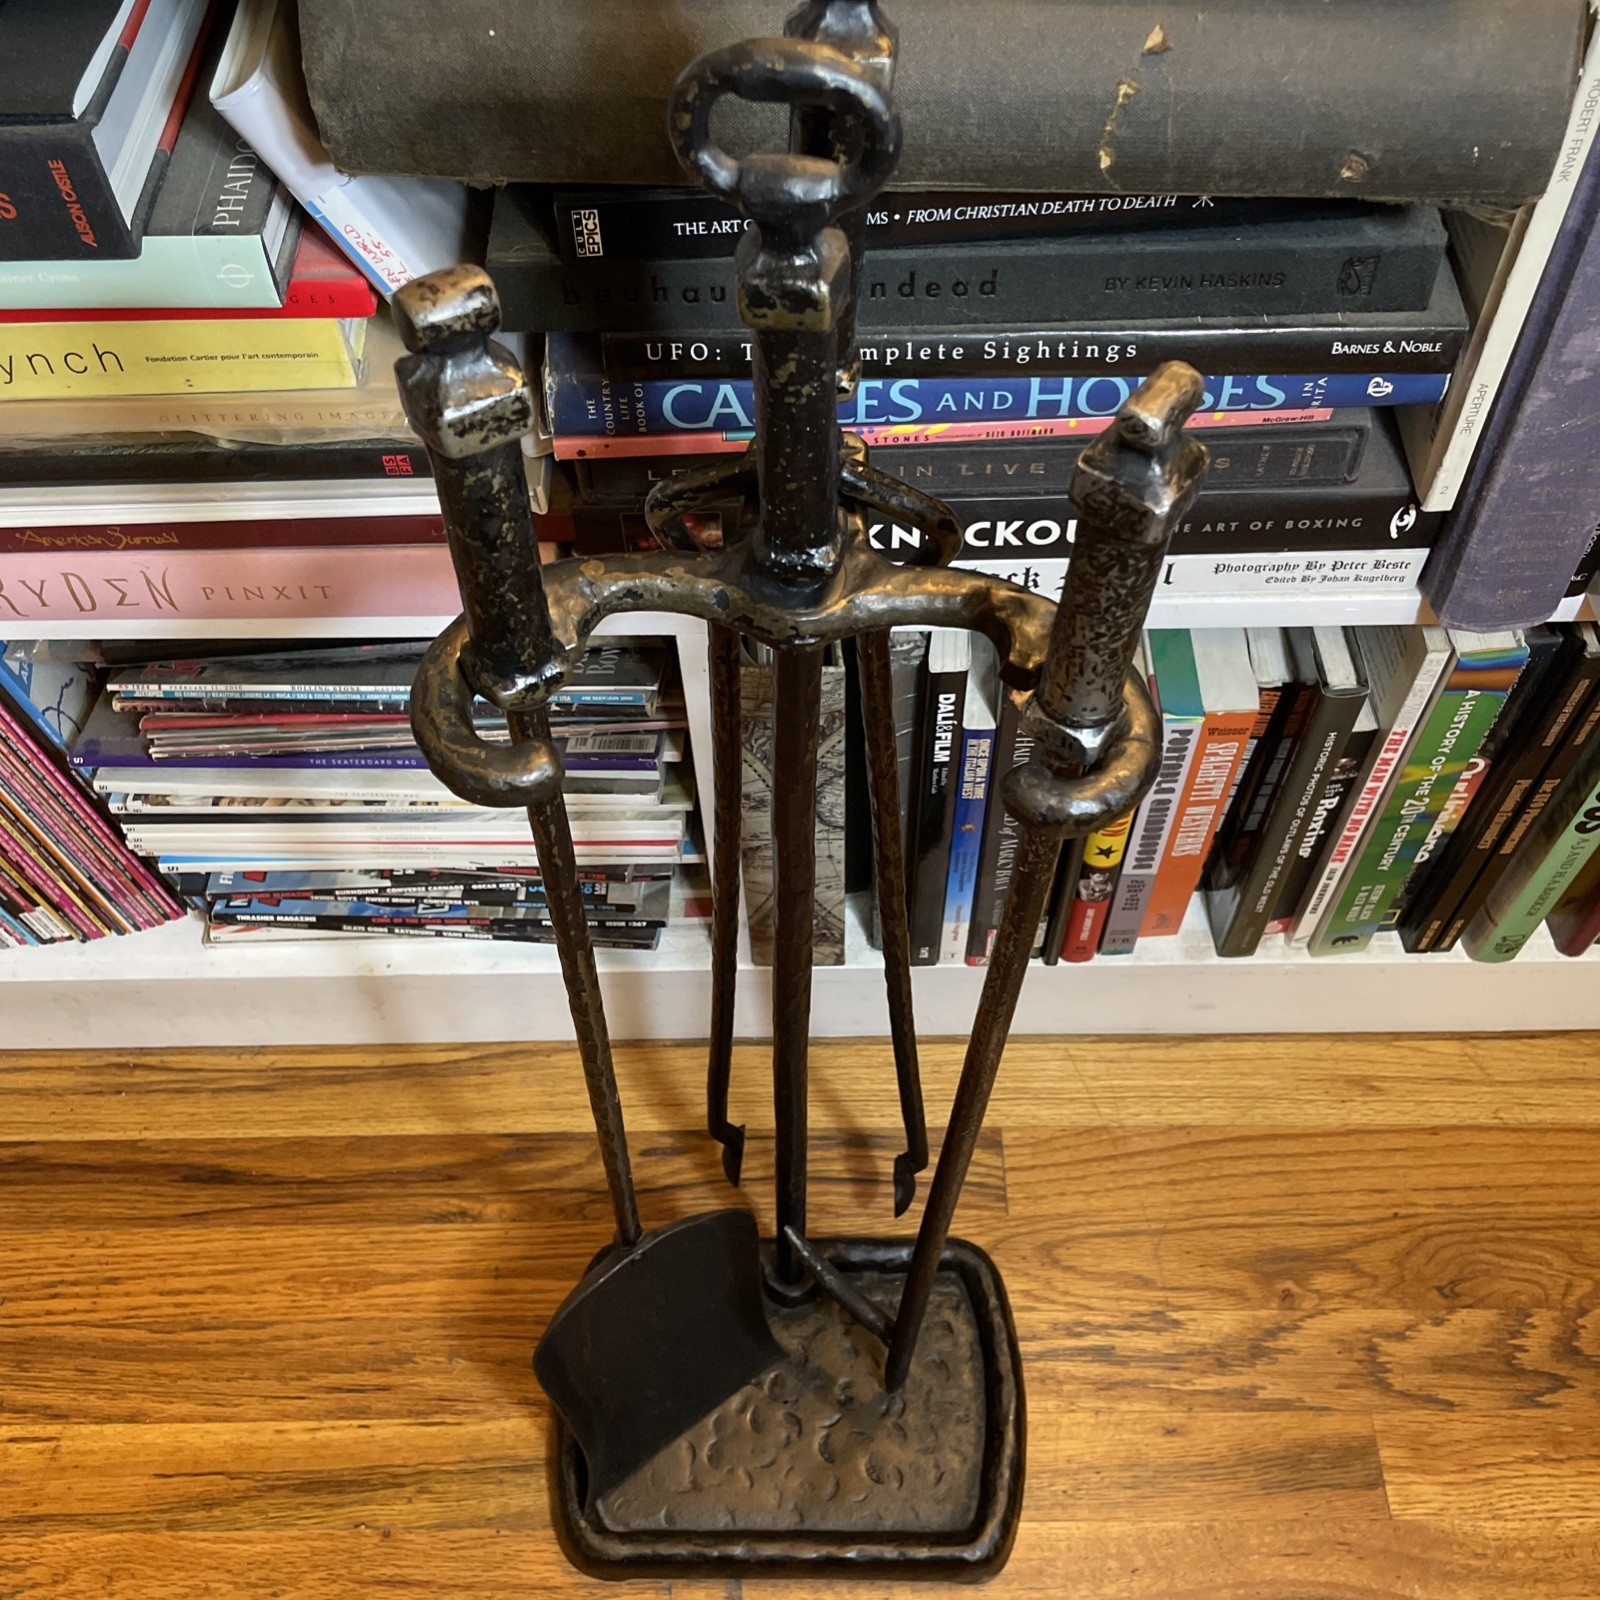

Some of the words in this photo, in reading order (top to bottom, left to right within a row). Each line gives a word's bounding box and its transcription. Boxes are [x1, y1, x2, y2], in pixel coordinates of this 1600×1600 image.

[1556, 139, 1583, 183] FRANK
[47, 159, 77, 202] CASTLE
[906, 208, 951, 225] FROM
[954, 203, 1039, 220] CHRISTIAN
[1041, 200, 1094, 215] DEATH
[1098, 197, 1121, 211] TO
[1122, 194, 1178, 210] DEATH
[66, 203, 98, 248] ALISON
[583, 210, 600, 255] EPICS
[673, 222, 708, 236] THE
[711, 220, 741, 234] ART
[1104, 276, 1130, 291] BY
[1135, 275, 1192, 291] KEVIN
[1200, 271, 1287, 290] HASKINS
[145, 354, 188, 363] Fondation
[190, 353, 219, 362] Cartier
[221, 353, 241, 363] pour
[242, 351, 260, 361] l'art
[261, 351, 319, 361] contemporain
[645, 342, 722, 362] UFO:
[983, 340, 1138, 365] Sightings
[1383, 341, 1396, 354] &
[586, 398, 597, 420] THE
[601, 377, 617, 436] COUNTRY
[619, 396, 630, 421] LIFE
[935, 391, 1013, 412] AND
[1459, 382, 1489, 436] APERTURE
[159, 411, 305, 424] GLITTERING
[635, 401, 648, 433] BOOK
[1261, 414, 1315, 424] McGraw-Hill
[873, 434, 930, 445] STONES
[960, 463, 1045, 476] LIVE
[1438, 485, 1450, 496] 2
[1202, 521, 1239, 533] ART
[1250, 520, 1275, 531] OF
[1285, 517, 1364, 530] BOXING
[1211, 561, 1301, 575] Photography
[1305, 561, 1327, 573] By
[1330, 560, 1368, 572] Peter
[1372, 559, 1412, 571] Beste
[1300, 575, 1317, 585] By
[1353, 573, 1406, 584] Kugelberg
[201, 584, 332, 602] PINXIT
[1464, 689, 1481, 700] A
[1437, 700, 1476, 754] HISTORY
[977, 738, 991, 757] ONCE
[1314, 731, 1338, 772] HISTORIC
[1383, 729, 1408, 755] THE
[964, 757, 977, 782] ITALIAN
[975, 757, 989, 778] UPON
[1189, 741, 1239, 801] SPAGHETTI
[1367, 757, 1395, 784] MAN
[1428, 756, 1446, 772] OF
[961, 782, 974, 800] WEST
[973, 782, 986, 800] TIME
[1299, 772, 1321, 806] PHOTOS
[1414, 773, 1438, 797] THE
[1353, 785, 1380, 816] WITH
[1295, 806, 1306, 818] OF
[1170, 804, 1217, 857] WESTERNS
[1345, 818, 1365, 833] NO
[1280, 819, 1302, 855] OUTLAWS
[1329, 834, 1356, 864] NAME
[1377, 824, 1411, 872] CENTURY
[1276, 855, 1286, 866] OF
[1270, 865, 1283, 880] THE
[386, 886, 426, 894] CONVERSE
[1263, 879, 1276, 896] OLD
[1255, 894, 1269, 914] WEST
[236, 914, 275, 922] THRASHER
[276, 915, 317, 923] MAGAZINE
